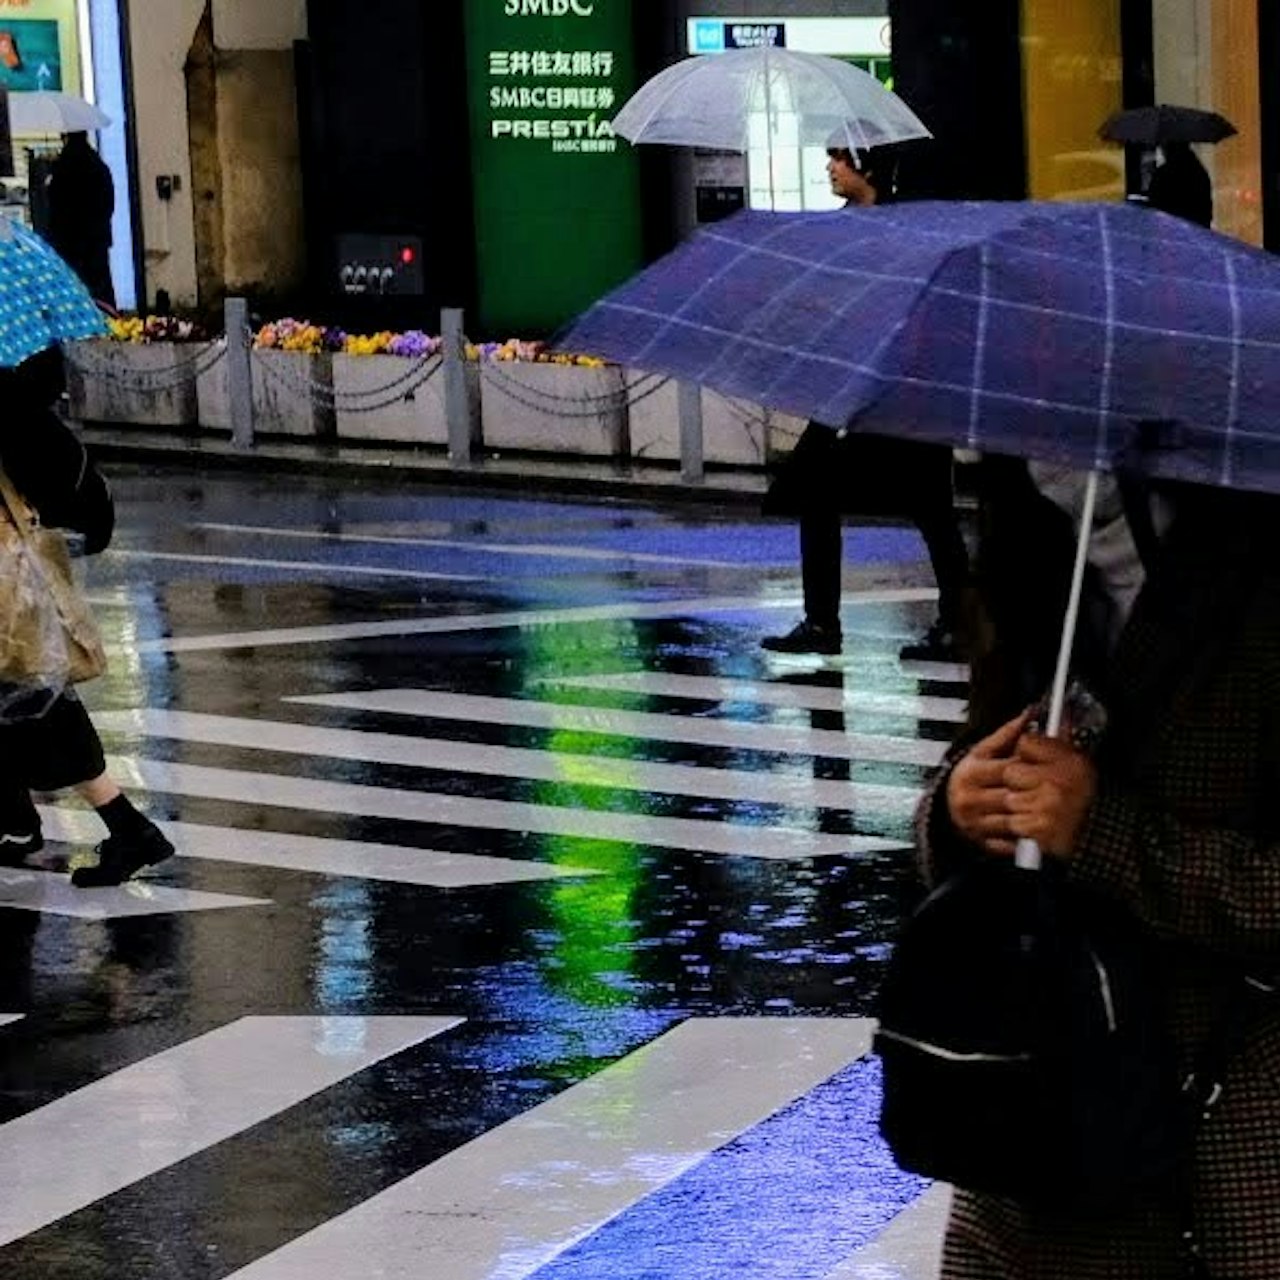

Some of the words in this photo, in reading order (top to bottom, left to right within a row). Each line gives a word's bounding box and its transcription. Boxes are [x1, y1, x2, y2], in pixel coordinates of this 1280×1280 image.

[504, 0, 593, 16] SMBC
[489, 50, 613, 76] 三井住友銀行
